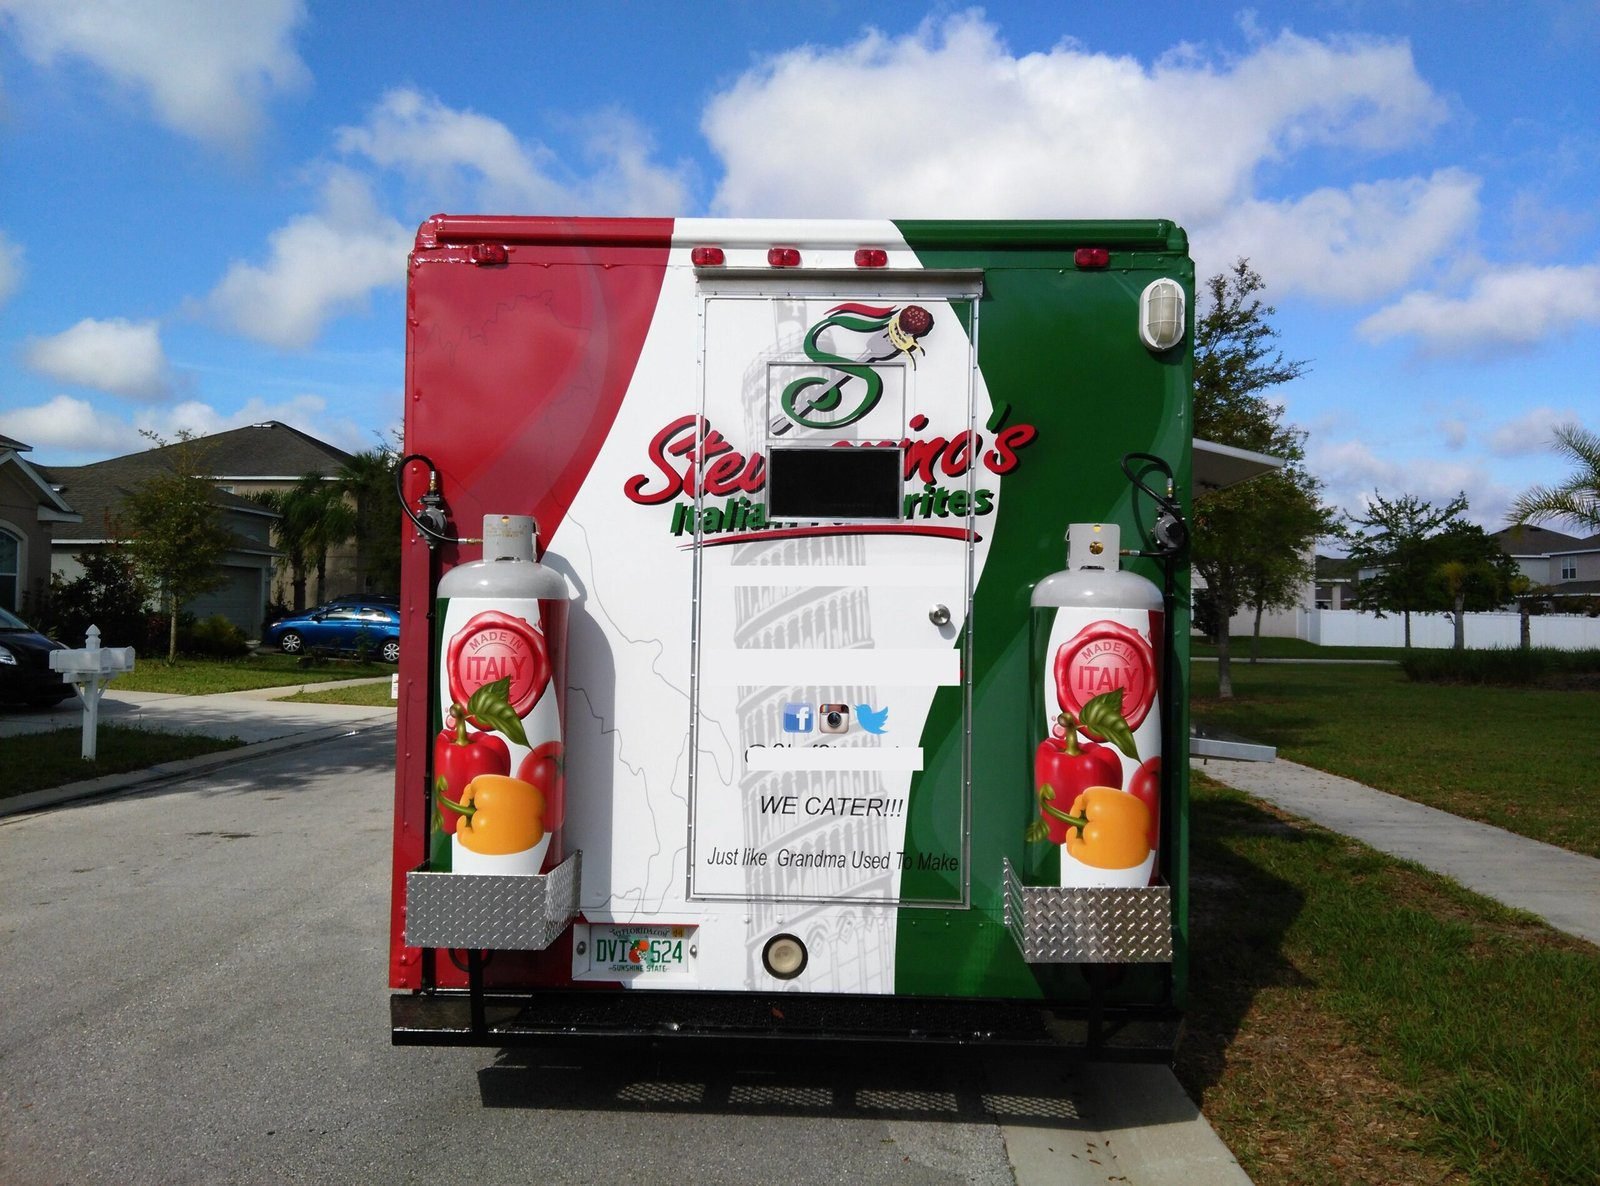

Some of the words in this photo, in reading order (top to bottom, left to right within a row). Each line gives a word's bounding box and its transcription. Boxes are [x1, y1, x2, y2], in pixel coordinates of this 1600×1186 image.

[670, 496, 797, 536] Italia
[468, 631, 508, 651] MADE
[510, 636, 525, 650] IN
[1081, 641, 1122, 660] MADE
[1123, 647, 1137, 661] IN
[466, 656, 528, 681] ITALY
[1078, 665, 1139, 693] ITALY
[760, 795, 799, 816] WE
[804, 796, 904, 818] CATER!!!
[707, 846, 739, 866] Just
[741, 847, 768, 867] like
[776, 848, 846, 870] Grandma
[851, 850, 891, 870] Used
[896, 851, 914, 871] To
[917, 851, 960, 872] Make
[595, 939, 628, 963] DVI
[646, 964, 667, 973] STATE
